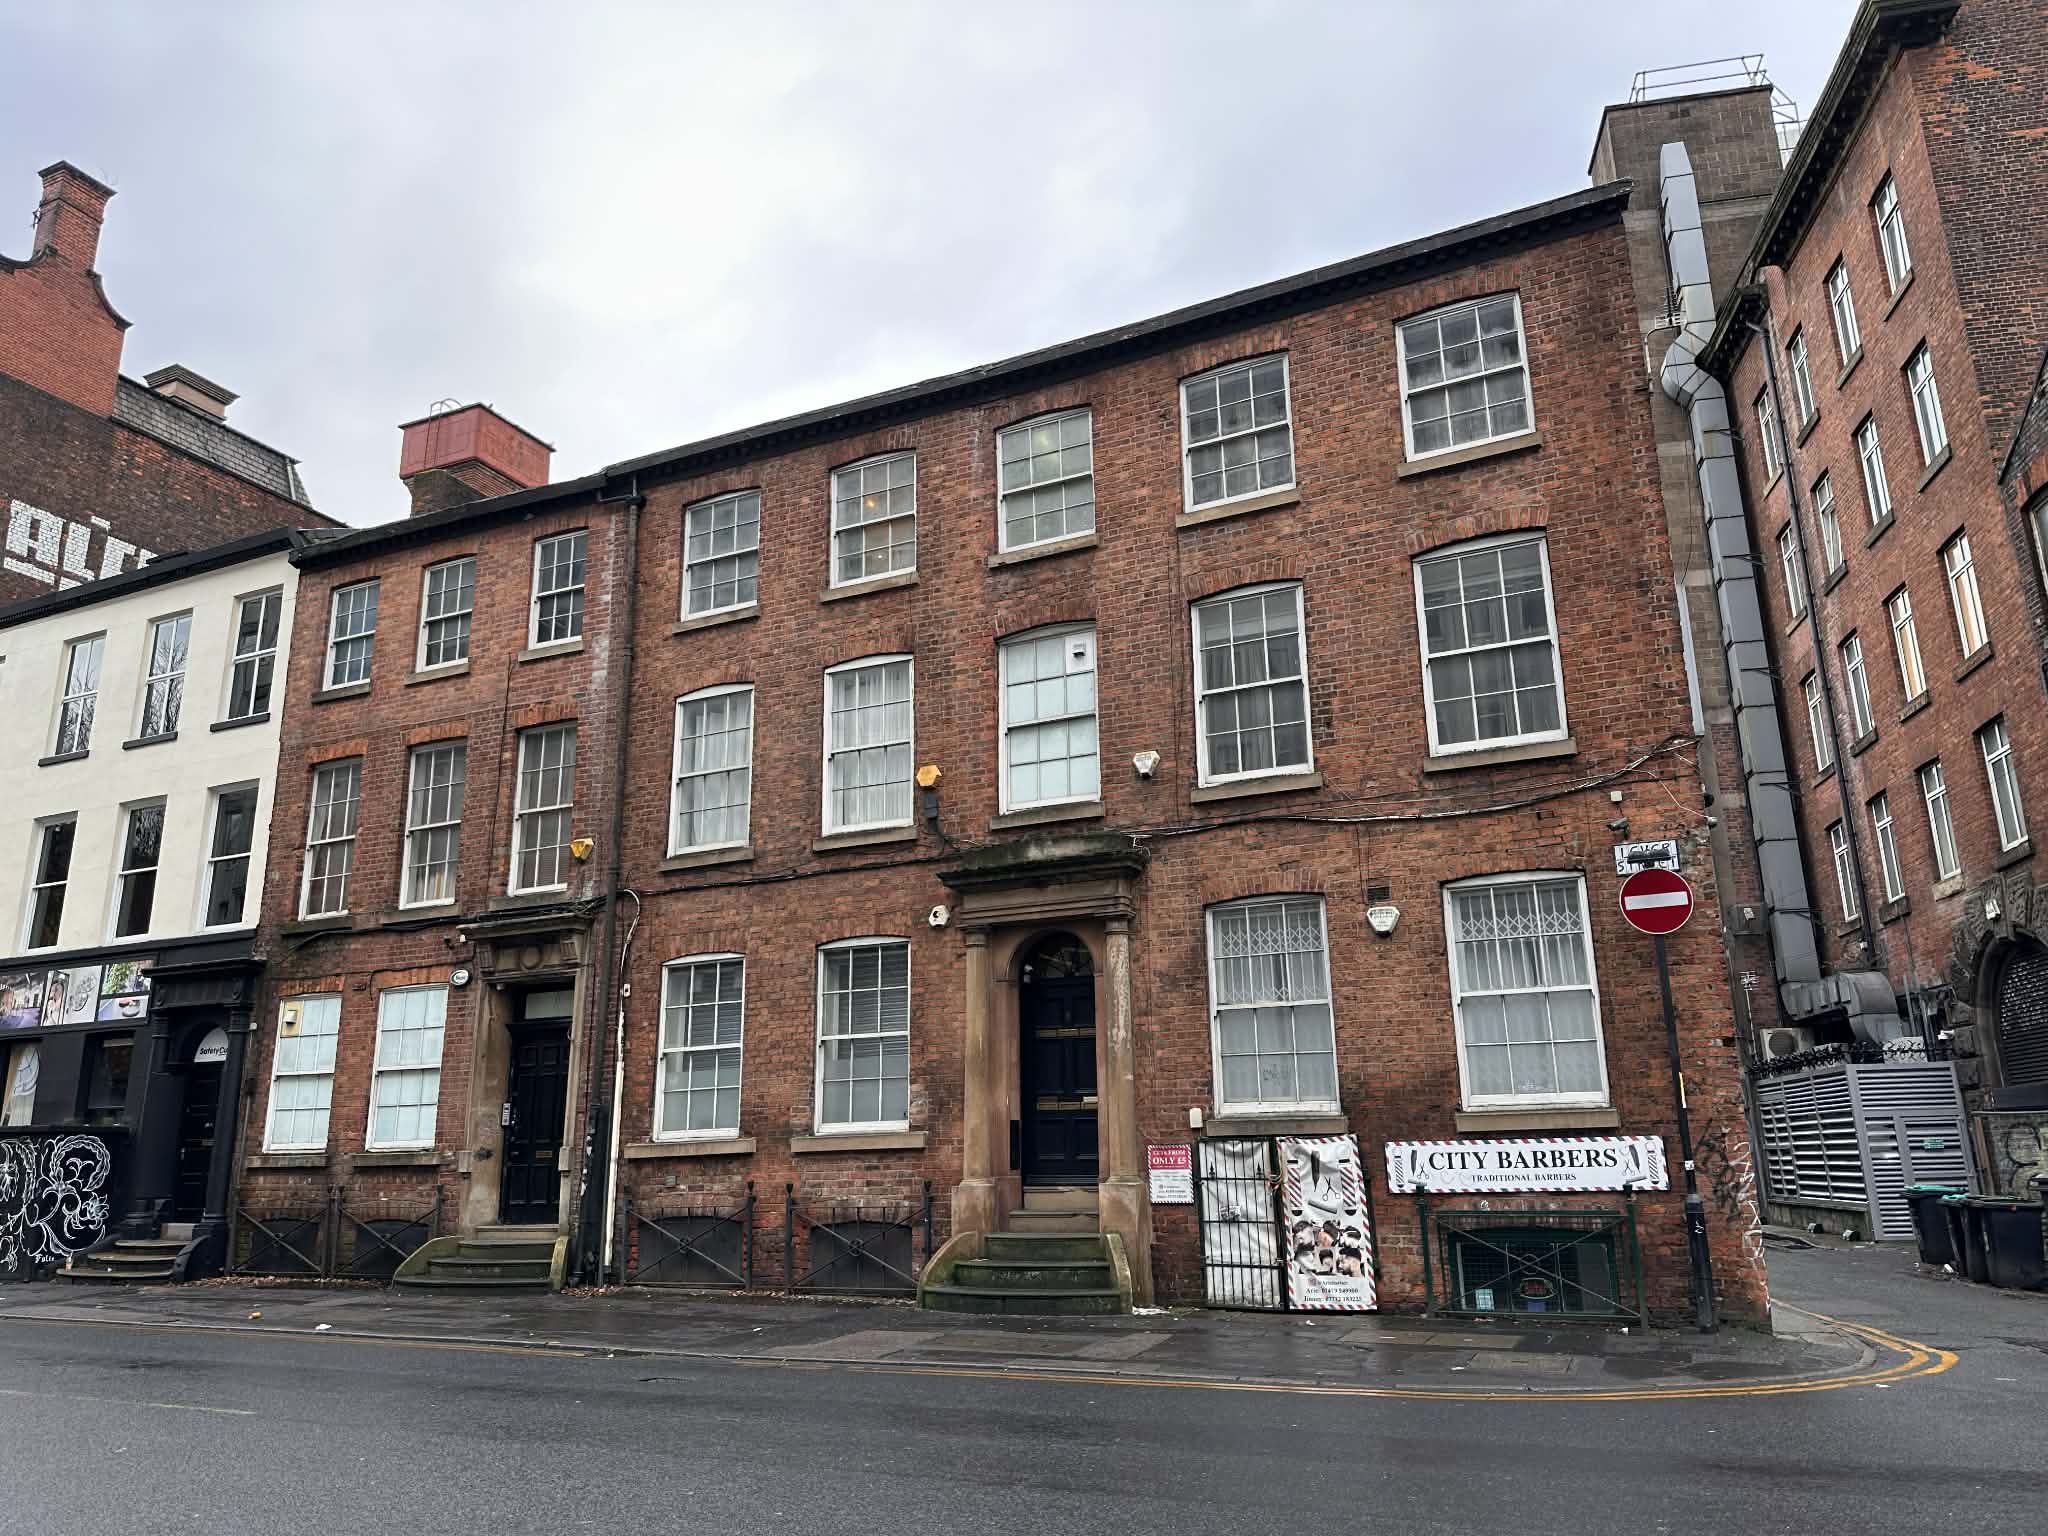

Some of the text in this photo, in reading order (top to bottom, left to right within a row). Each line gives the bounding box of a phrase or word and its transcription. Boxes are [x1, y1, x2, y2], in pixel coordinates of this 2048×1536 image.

[1617, 855, 1677, 873] STET
[1152, 1157, 1175, 1165] ONLY
[1428, 1148, 1618, 1170] CITY BARBERS
[1472, 1173, 1577, 1182] TRADITIONAL BARBERS
